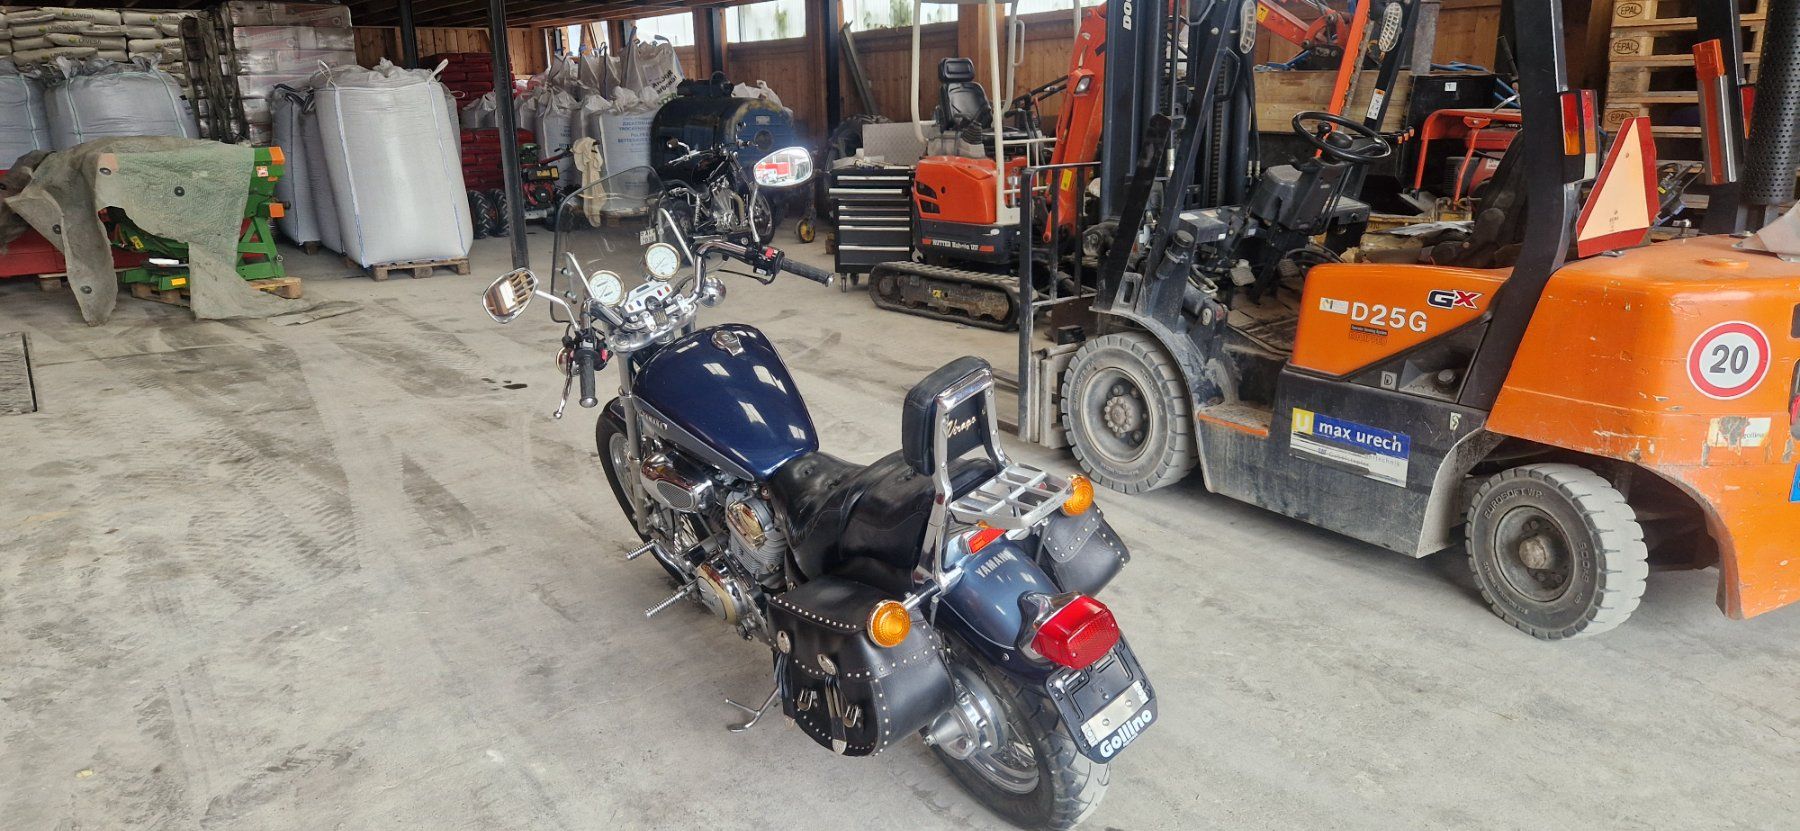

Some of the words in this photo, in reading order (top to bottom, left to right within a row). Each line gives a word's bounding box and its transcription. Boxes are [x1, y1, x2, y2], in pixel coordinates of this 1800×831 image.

[1123, 0, 1132, 30] DO
[1620, 5, 1638, 15] EPAL
[1616, 42, 1635, 51] EPAL
[1427, 289, 1483, 309] GX
[1351, 302, 1428, 333] D25G
[1710, 344, 1749, 375] 20
[1319, 421, 1352, 440] max
[1356, 431, 1402, 452] urech
[1100, 709, 1153, 758] Gollino
